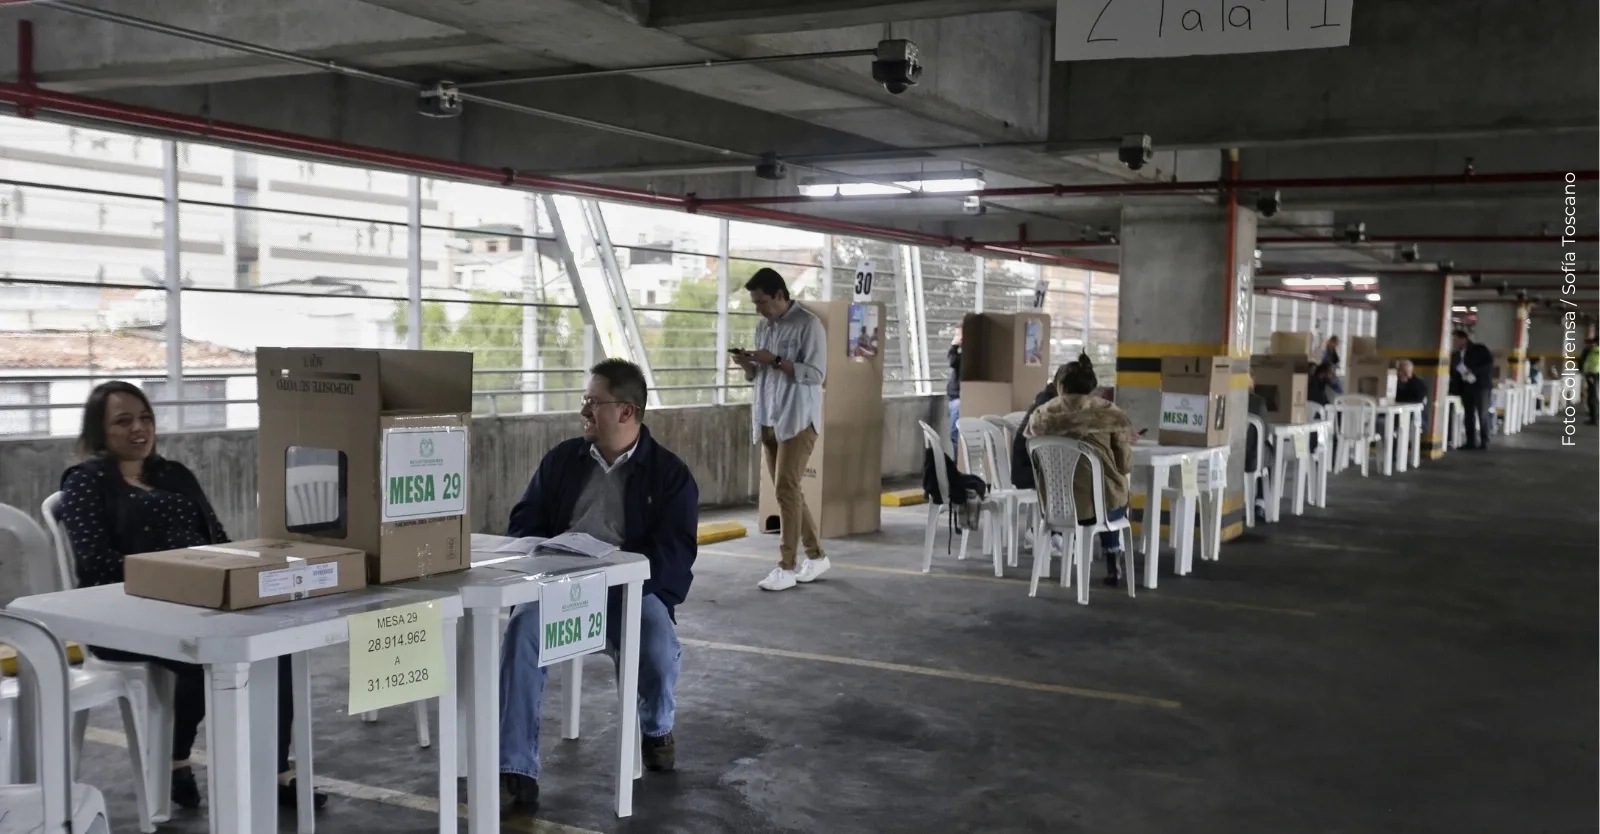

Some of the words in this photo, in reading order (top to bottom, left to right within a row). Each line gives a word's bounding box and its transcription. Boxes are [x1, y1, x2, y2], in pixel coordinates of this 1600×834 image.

[1181, 9, 1204, 32] a
[855, 272, 873, 295] 30
[1163, 412, 1188, 425] MESA
[1191, 414, 1203, 427] 30
[389, 474, 435, 505] MESA
[442, 472, 461, 500] 29
[377, 614, 406, 628] MESA
[407, 612, 418, 624] 29
[545, 616, 582, 650] MESA
[587, 611, 603, 638] 29
[367, 629, 427, 653] 28.914.962
[394, 656, 401, 666] A
[367, 668, 429, 693] 31.192.328
